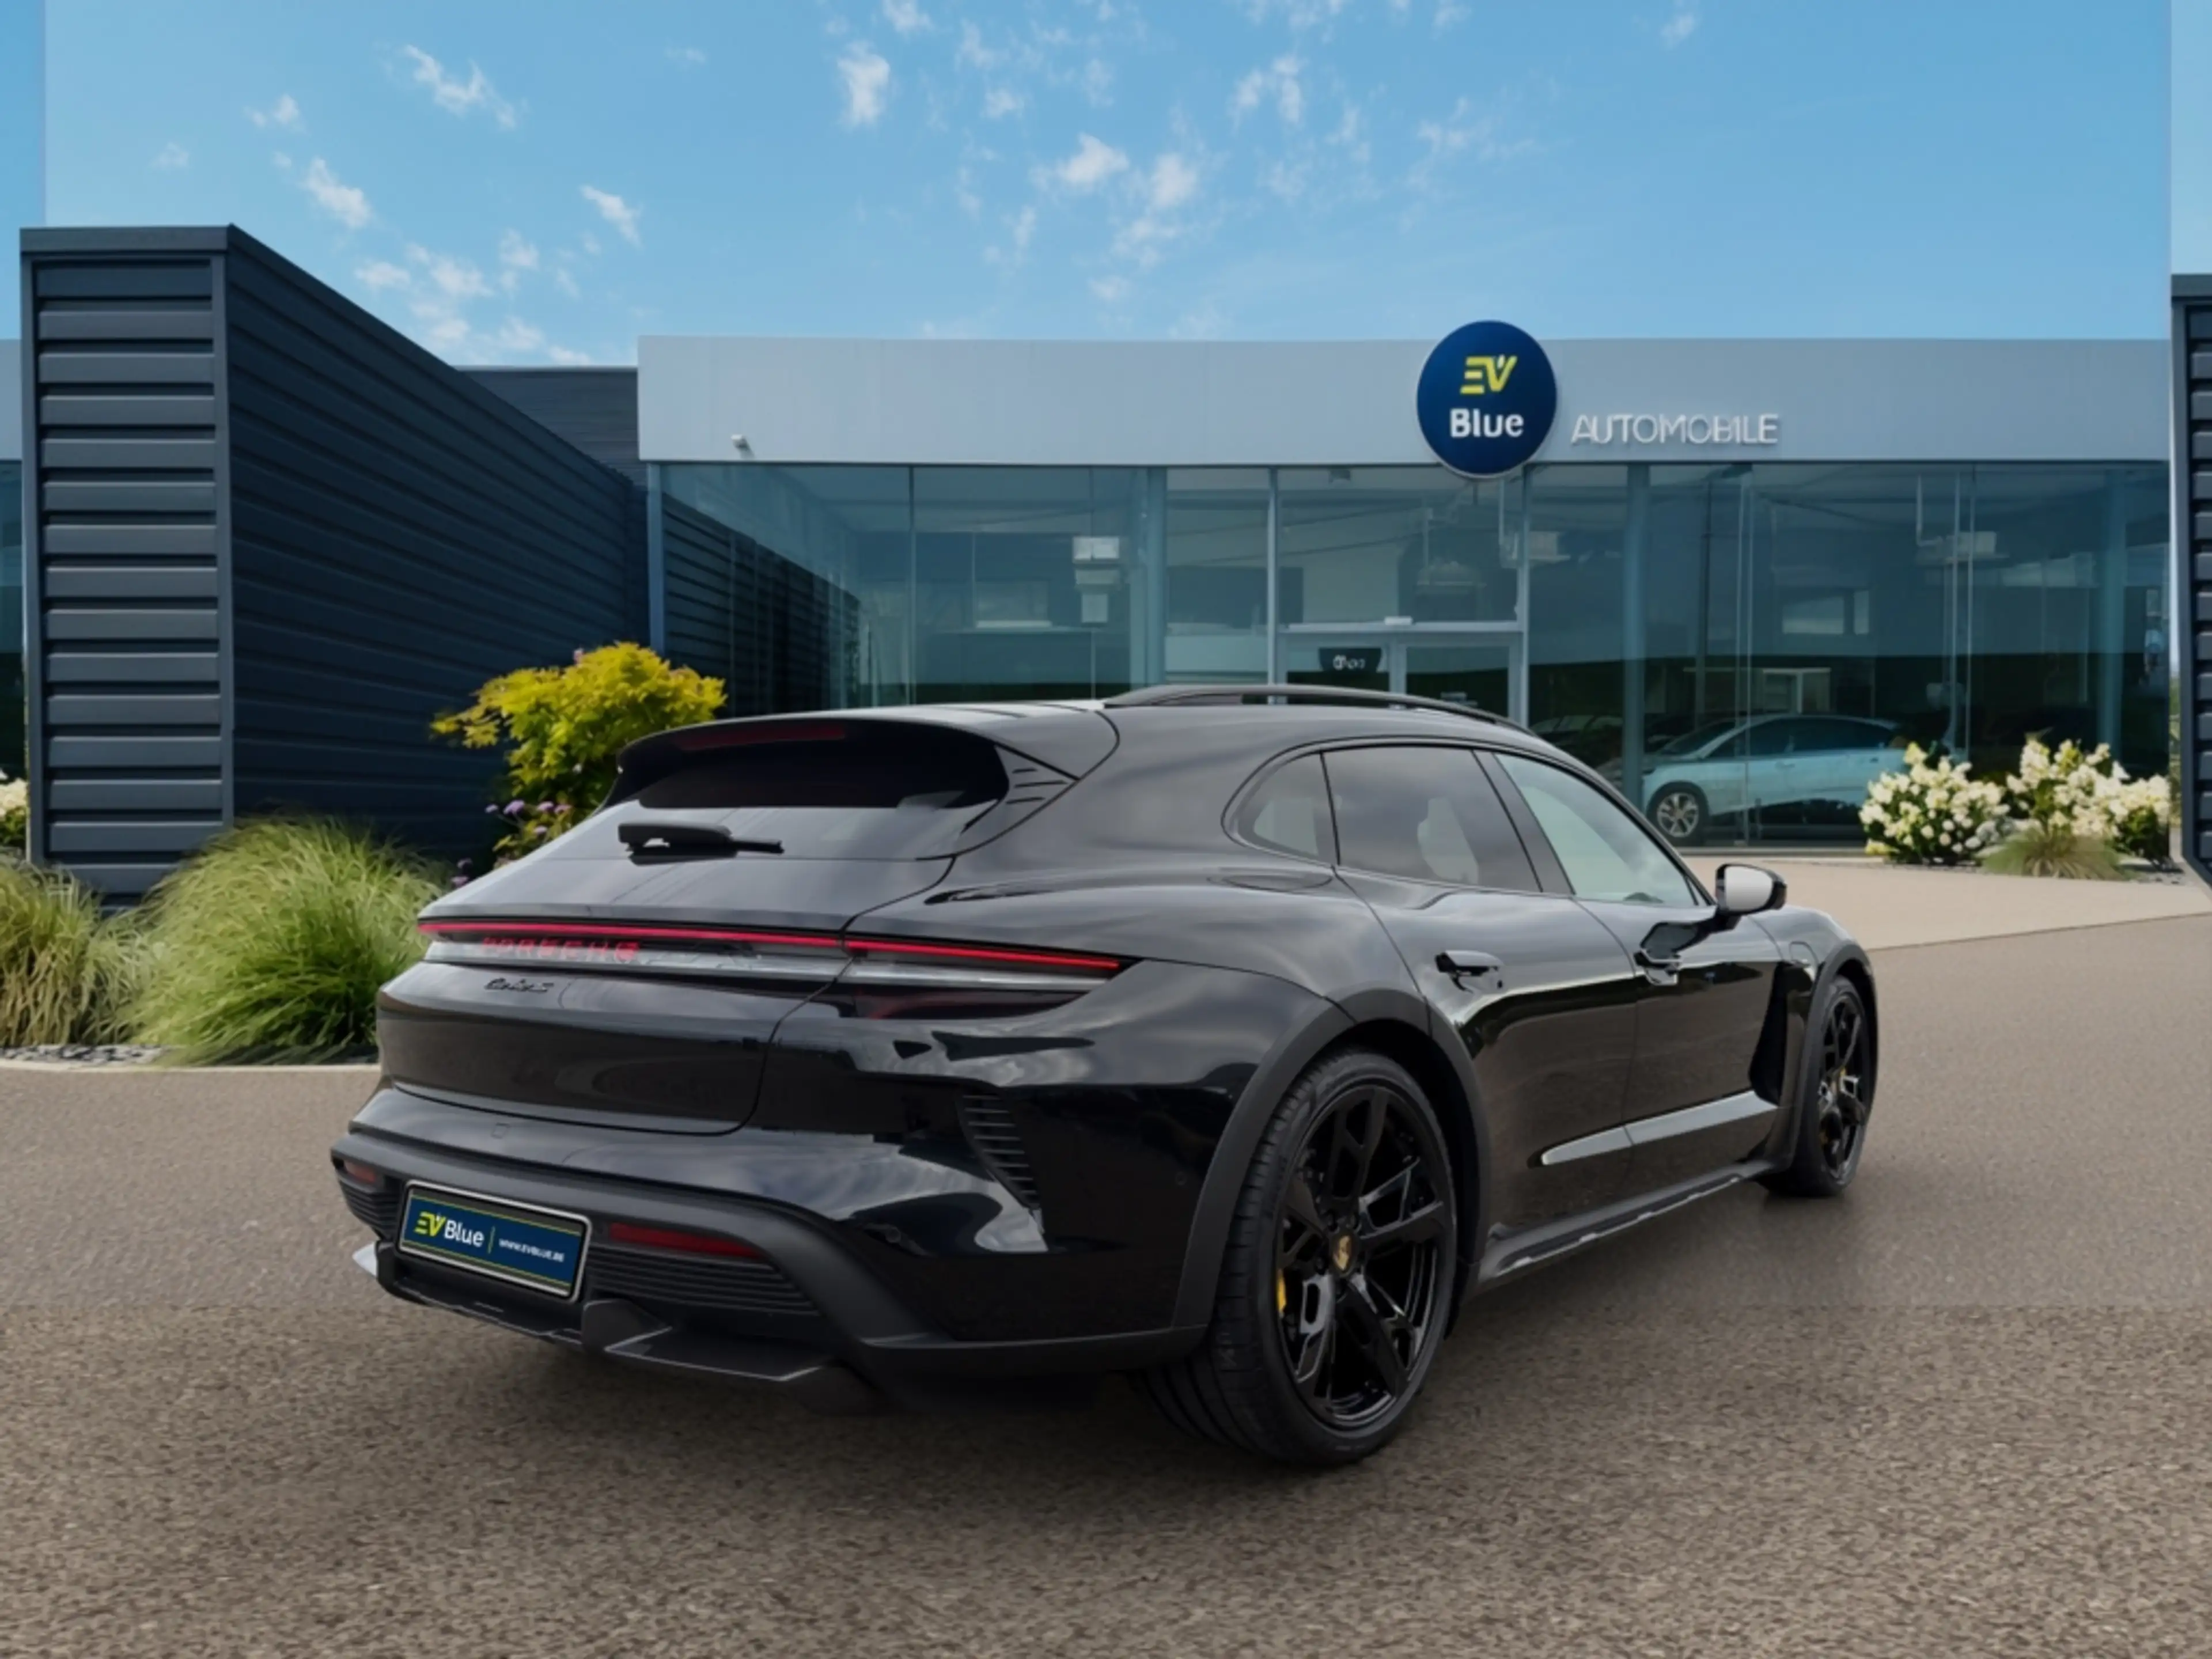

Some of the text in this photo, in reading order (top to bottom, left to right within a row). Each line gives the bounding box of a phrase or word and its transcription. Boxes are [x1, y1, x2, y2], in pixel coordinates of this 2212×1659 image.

[1460, 355, 1517, 394] EV
[1450, 408, 1524, 438] Blue
[1571, 413, 1780, 444] AUTOMOBILE
[444, 1220, 484, 1247] Blue
